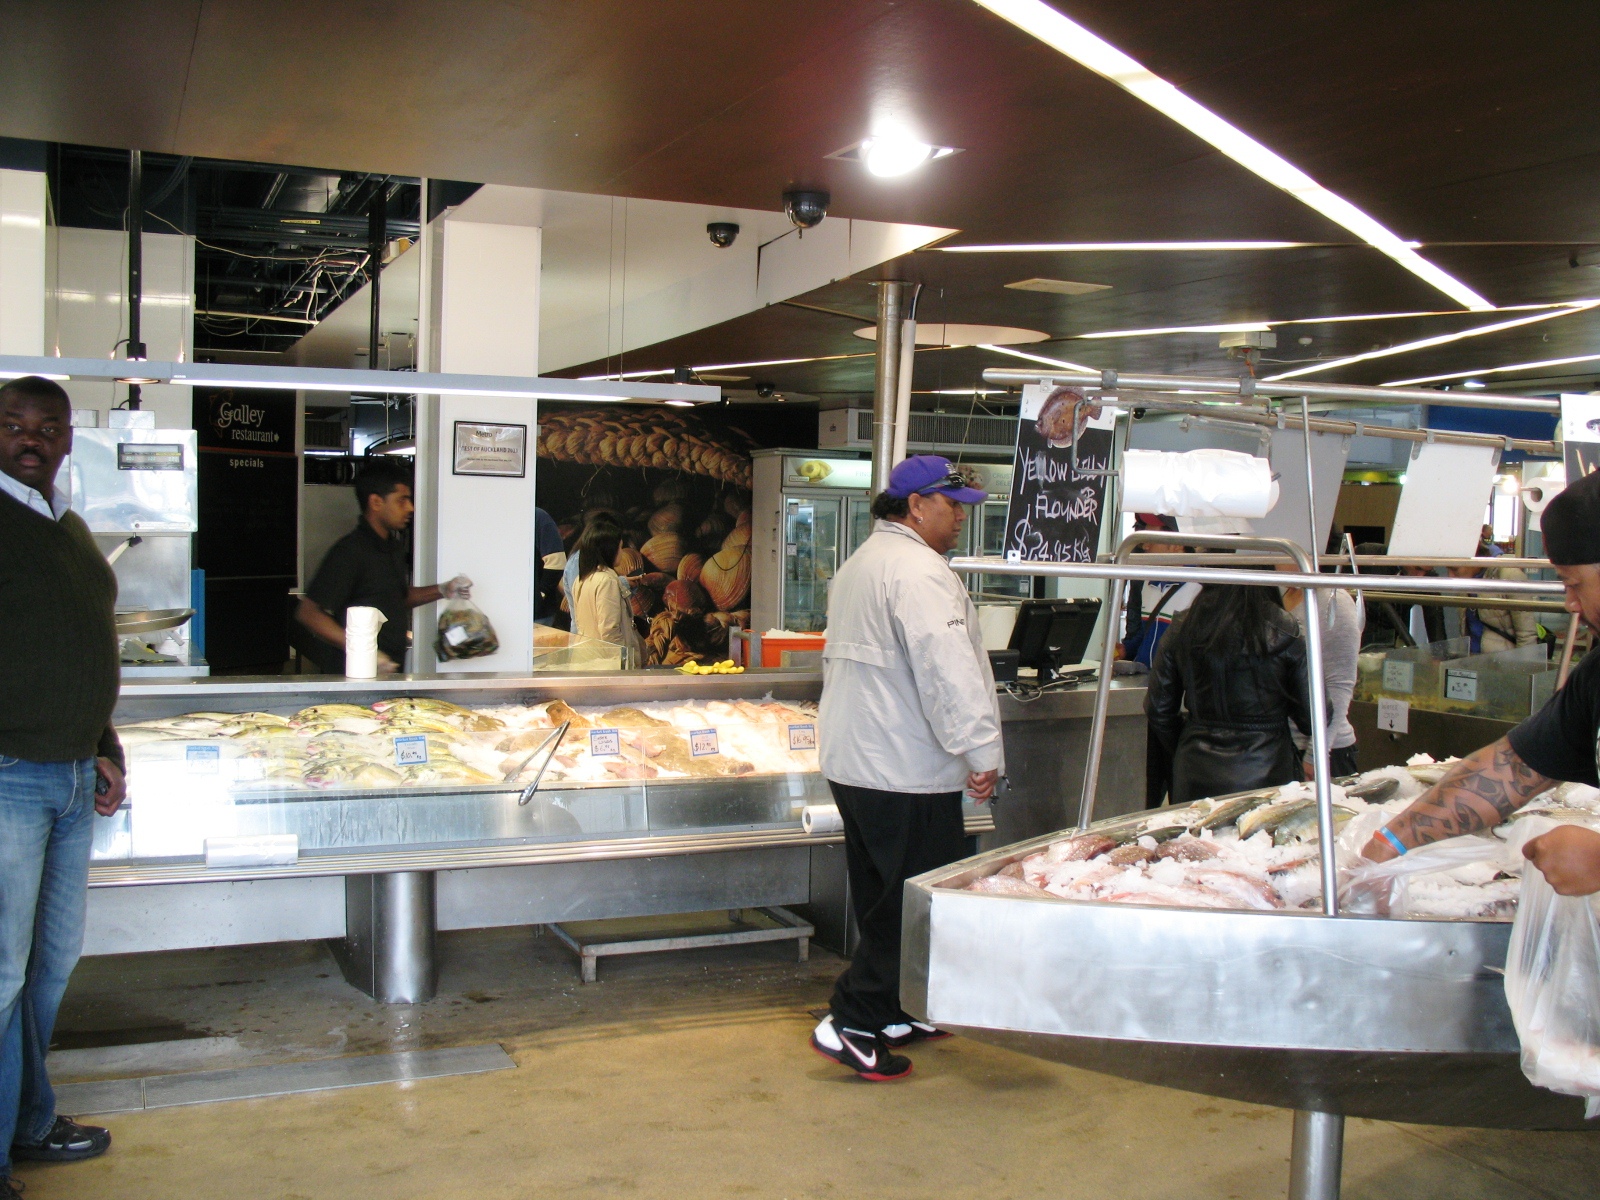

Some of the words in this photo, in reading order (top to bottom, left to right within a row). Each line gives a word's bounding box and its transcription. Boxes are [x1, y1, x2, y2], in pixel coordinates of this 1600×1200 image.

[217, 402, 266, 428] Galley
[231, 429, 274, 442] restaurant
[229, 457, 264, 469] specials
[1019, 446, 1068, 495] YELLOW
[1071, 454, 1107, 488] BELLY
[1035, 493, 1098, 526] FLOUNDER
